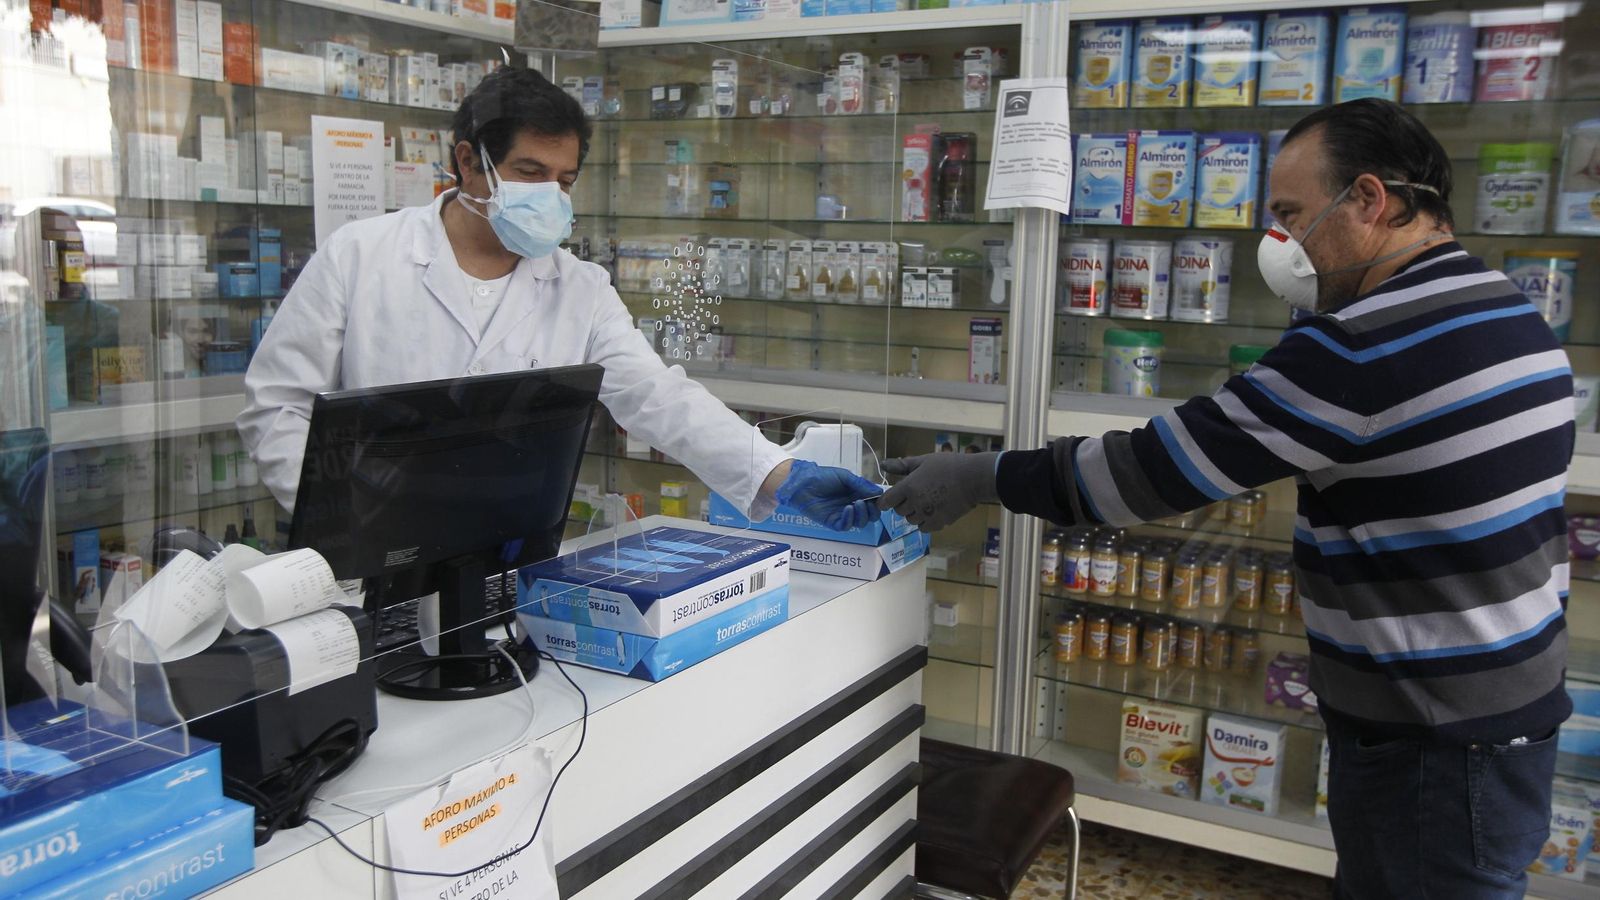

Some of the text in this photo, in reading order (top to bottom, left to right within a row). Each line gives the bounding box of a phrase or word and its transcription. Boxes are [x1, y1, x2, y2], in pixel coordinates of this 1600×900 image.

[1078, 38, 1122, 50] Almirón
[1266, 32, 1316, 47] Almirón
[1415, 58, 1427, 84] 1
[1523, 56, 1541, 81] 2
[1108, 84, 1115, 98] 1
[1167, 83, 1178, 98] 2
[1236, 82, 1243, 97] 1
[1302, 83, 1314, 100] 2
[1383, 78, 1390, 93] 1
[1079, 157, 1122, 168] Almirón
[1140, 151, 1186, 162] Almirón
[1202, 155, 1248, 167] Almirón
[1124, 177, 1133, 214] FORMATO
[1113, 204, 1122, 219] 1
[1169, 200, 1181, 215] 2
[1234, 203, 1242, 217] 1
[1554, 300, 1561, 313] 1
[790, 549, 862, 568] rascontrast
[673, 582, 745, 623] torrascontrast
[716, 603, 781, 642] torrascontrast
[546, 634, 617, 657] torrascontrast
[1125, 713, 1182, 736] Blevit
[1214, 728, 1269, 751] Damira
[424, 773, 516, 831] AFORO MÁXIMO 4
[444, 804, 497, 843] PERSONAS
[450, 880, 464, 897] VE
[465, 875, 471, 888] 4
[472, 843, 522, 883] PERSONAS
[492, 878, 505, 896] DE
[507, 869, 519, 886] LA
